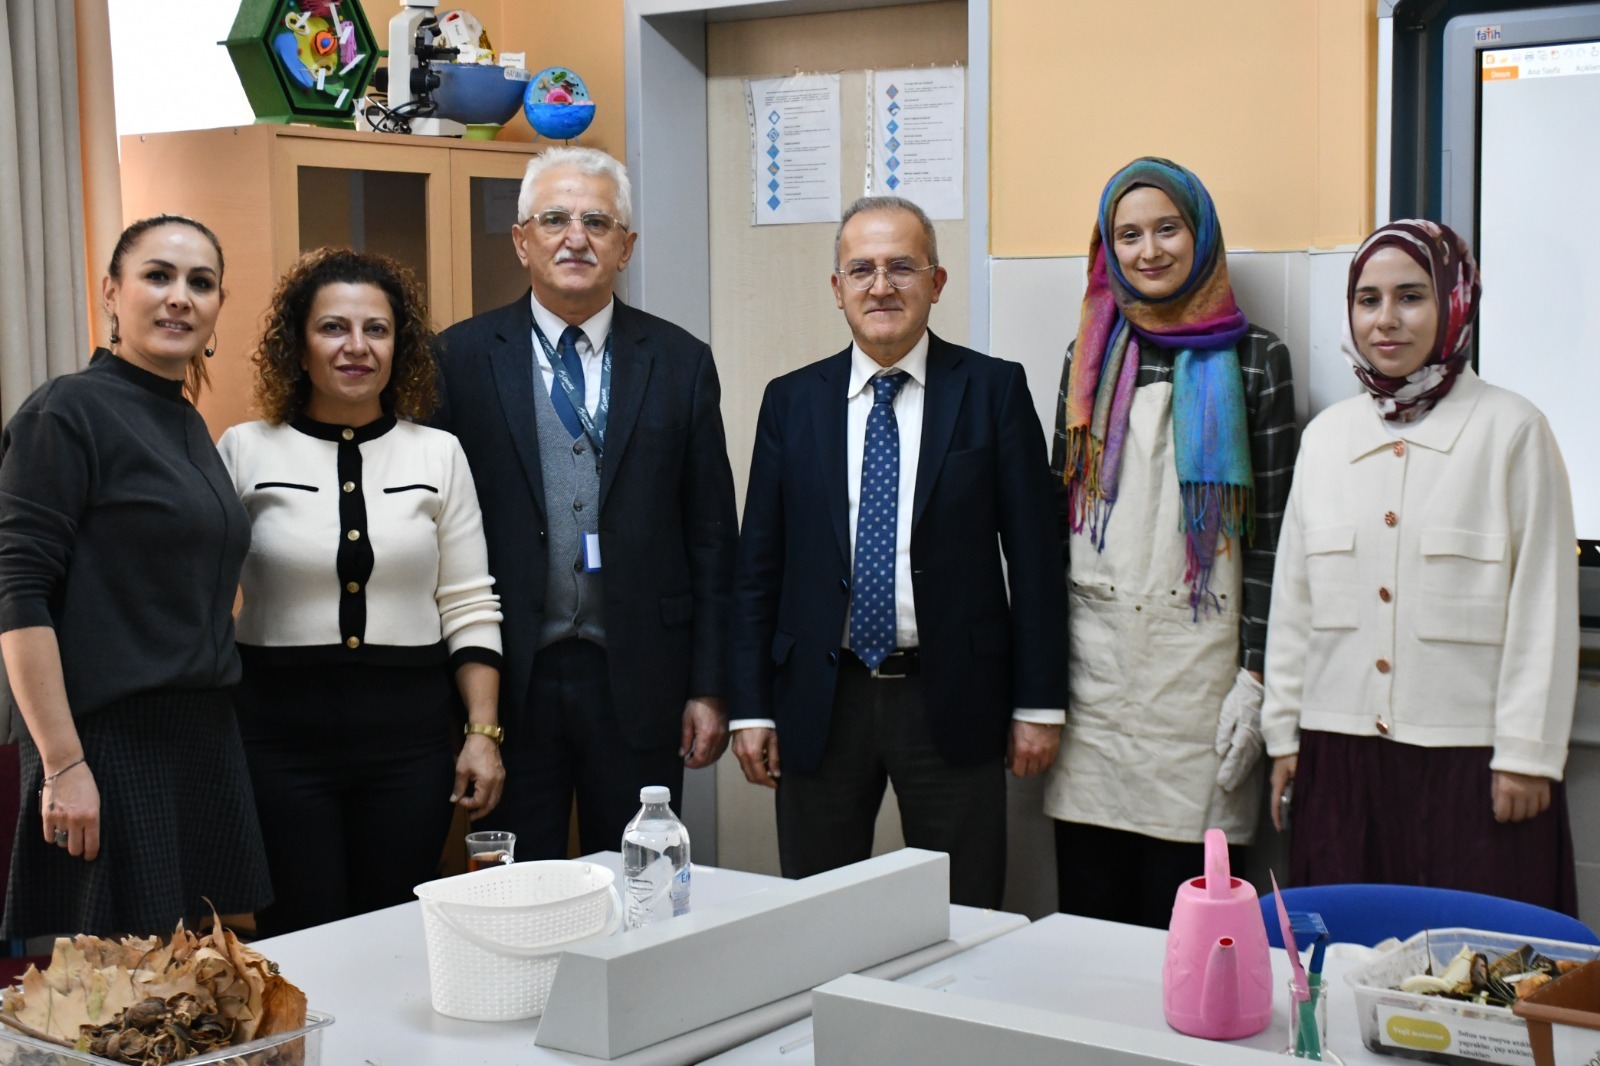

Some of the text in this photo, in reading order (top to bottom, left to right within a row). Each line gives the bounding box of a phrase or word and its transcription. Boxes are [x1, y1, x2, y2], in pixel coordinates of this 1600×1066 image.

[1477, 27, 1501, 41] fatih
[1458, 1030, 1478, 1039] Sebze
[1489, 1036, 1511, 1045] meyve
